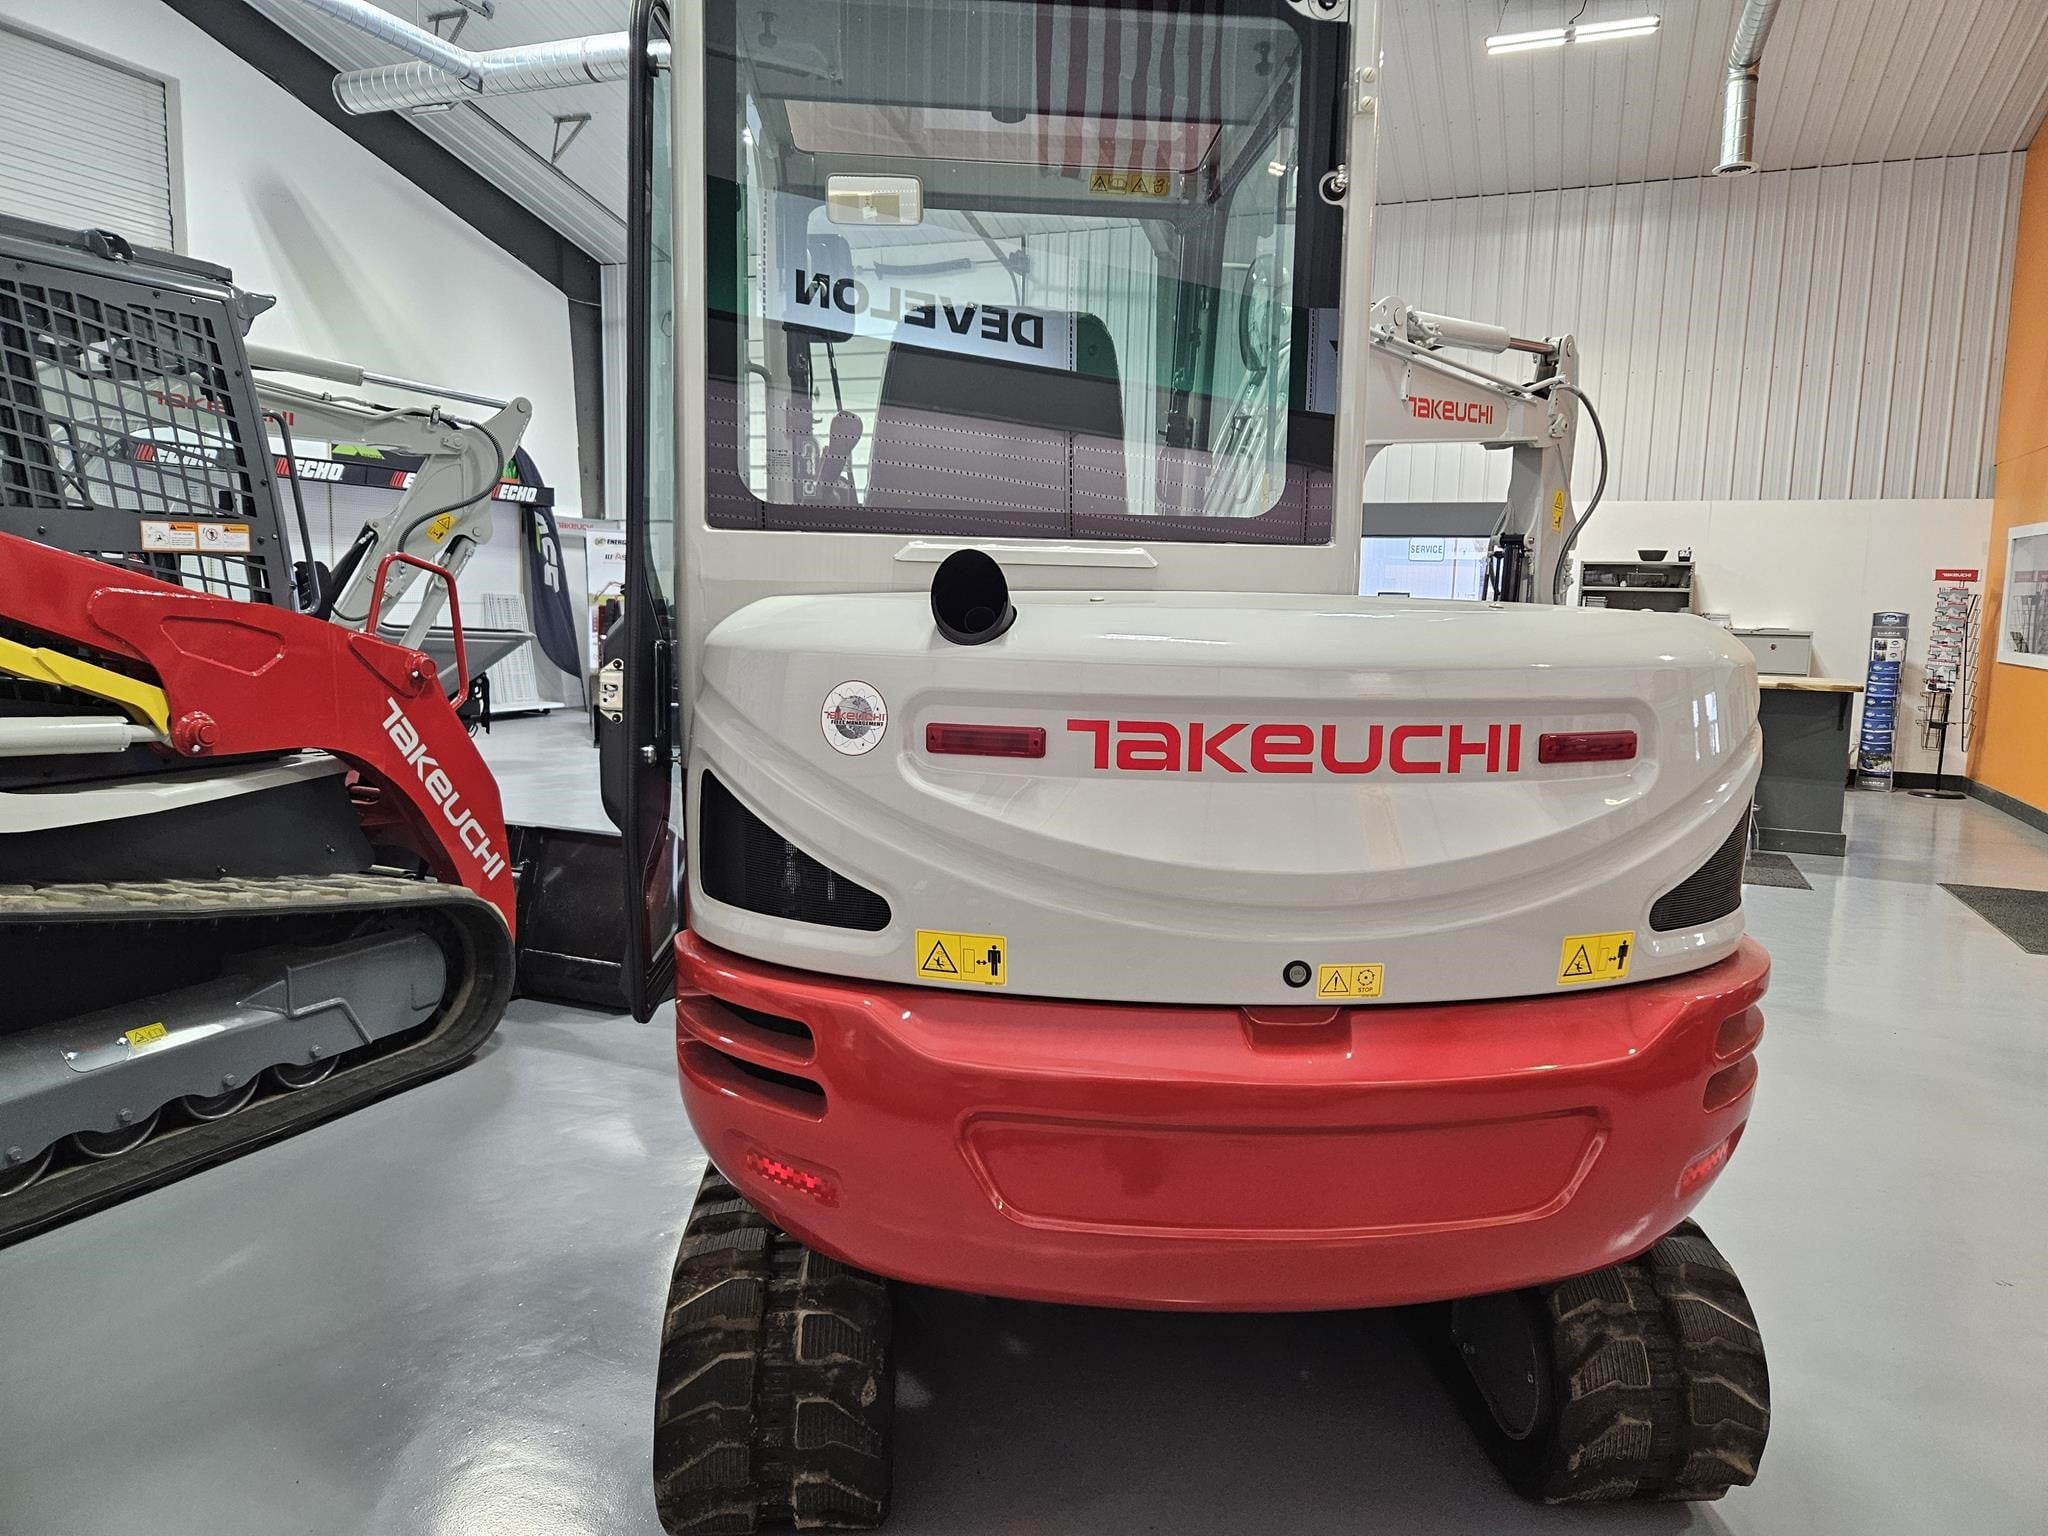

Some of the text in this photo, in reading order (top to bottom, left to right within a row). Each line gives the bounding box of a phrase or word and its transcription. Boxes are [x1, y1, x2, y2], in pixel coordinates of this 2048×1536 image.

[1408, 396, 1494, 425] TAKEUCHI
[294, 458, 345, 481] ECHO
[498, 484, 538, 503] ECHO
[1410, 545, 1443, 554] SERVICE
[823, 711, 885, 721] TAKEUCHI
[1066, 719, 1521, 774] TAKEUCHI
[382, 696, 506, 881] TAKEUCHI
